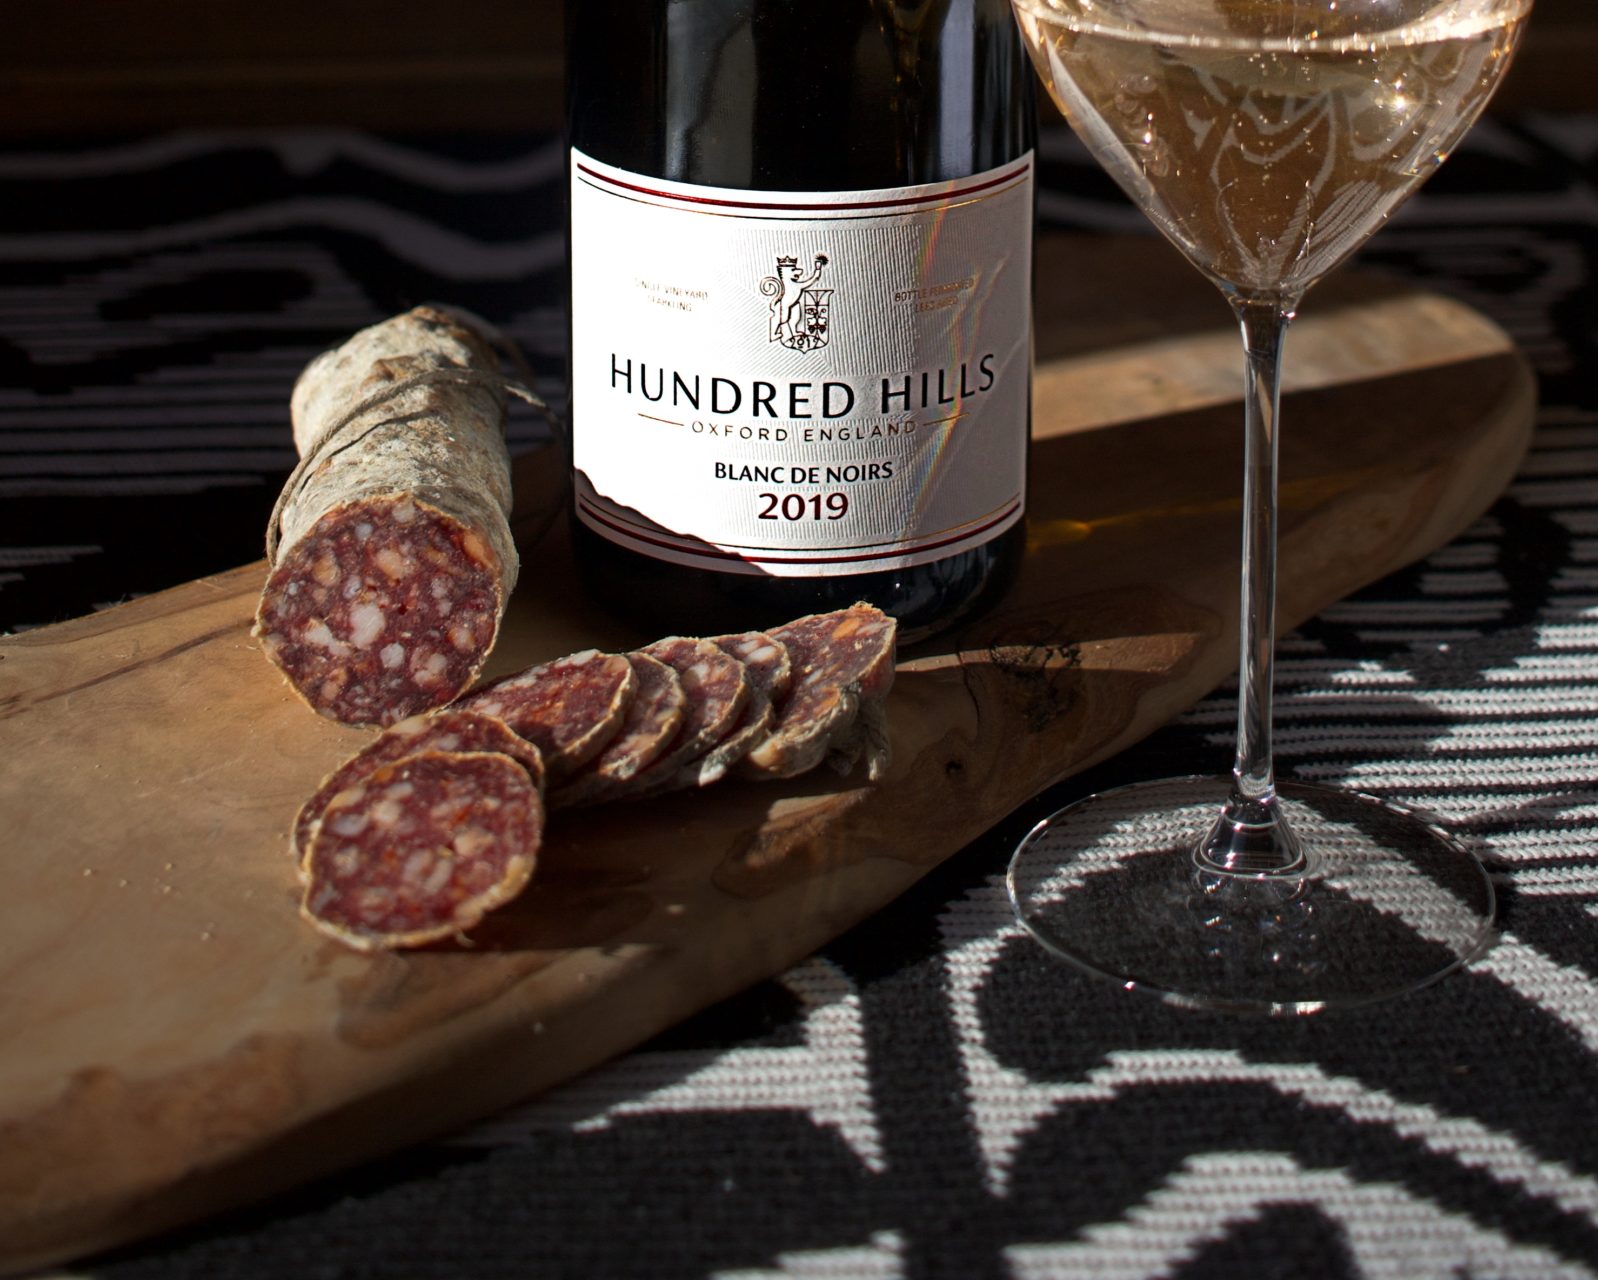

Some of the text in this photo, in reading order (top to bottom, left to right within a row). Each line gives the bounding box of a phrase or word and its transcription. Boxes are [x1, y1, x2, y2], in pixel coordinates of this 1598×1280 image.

[894, 287, 928, 302] BOTTLE
[611, 353, 995, 419] HUNDRED HILLS
[691, 420, 917, 442] OXFORD ENGLAND
[714, 461, 893, 484] BLANC DE NOIRS
[757, 492, 849, 522] 2019
